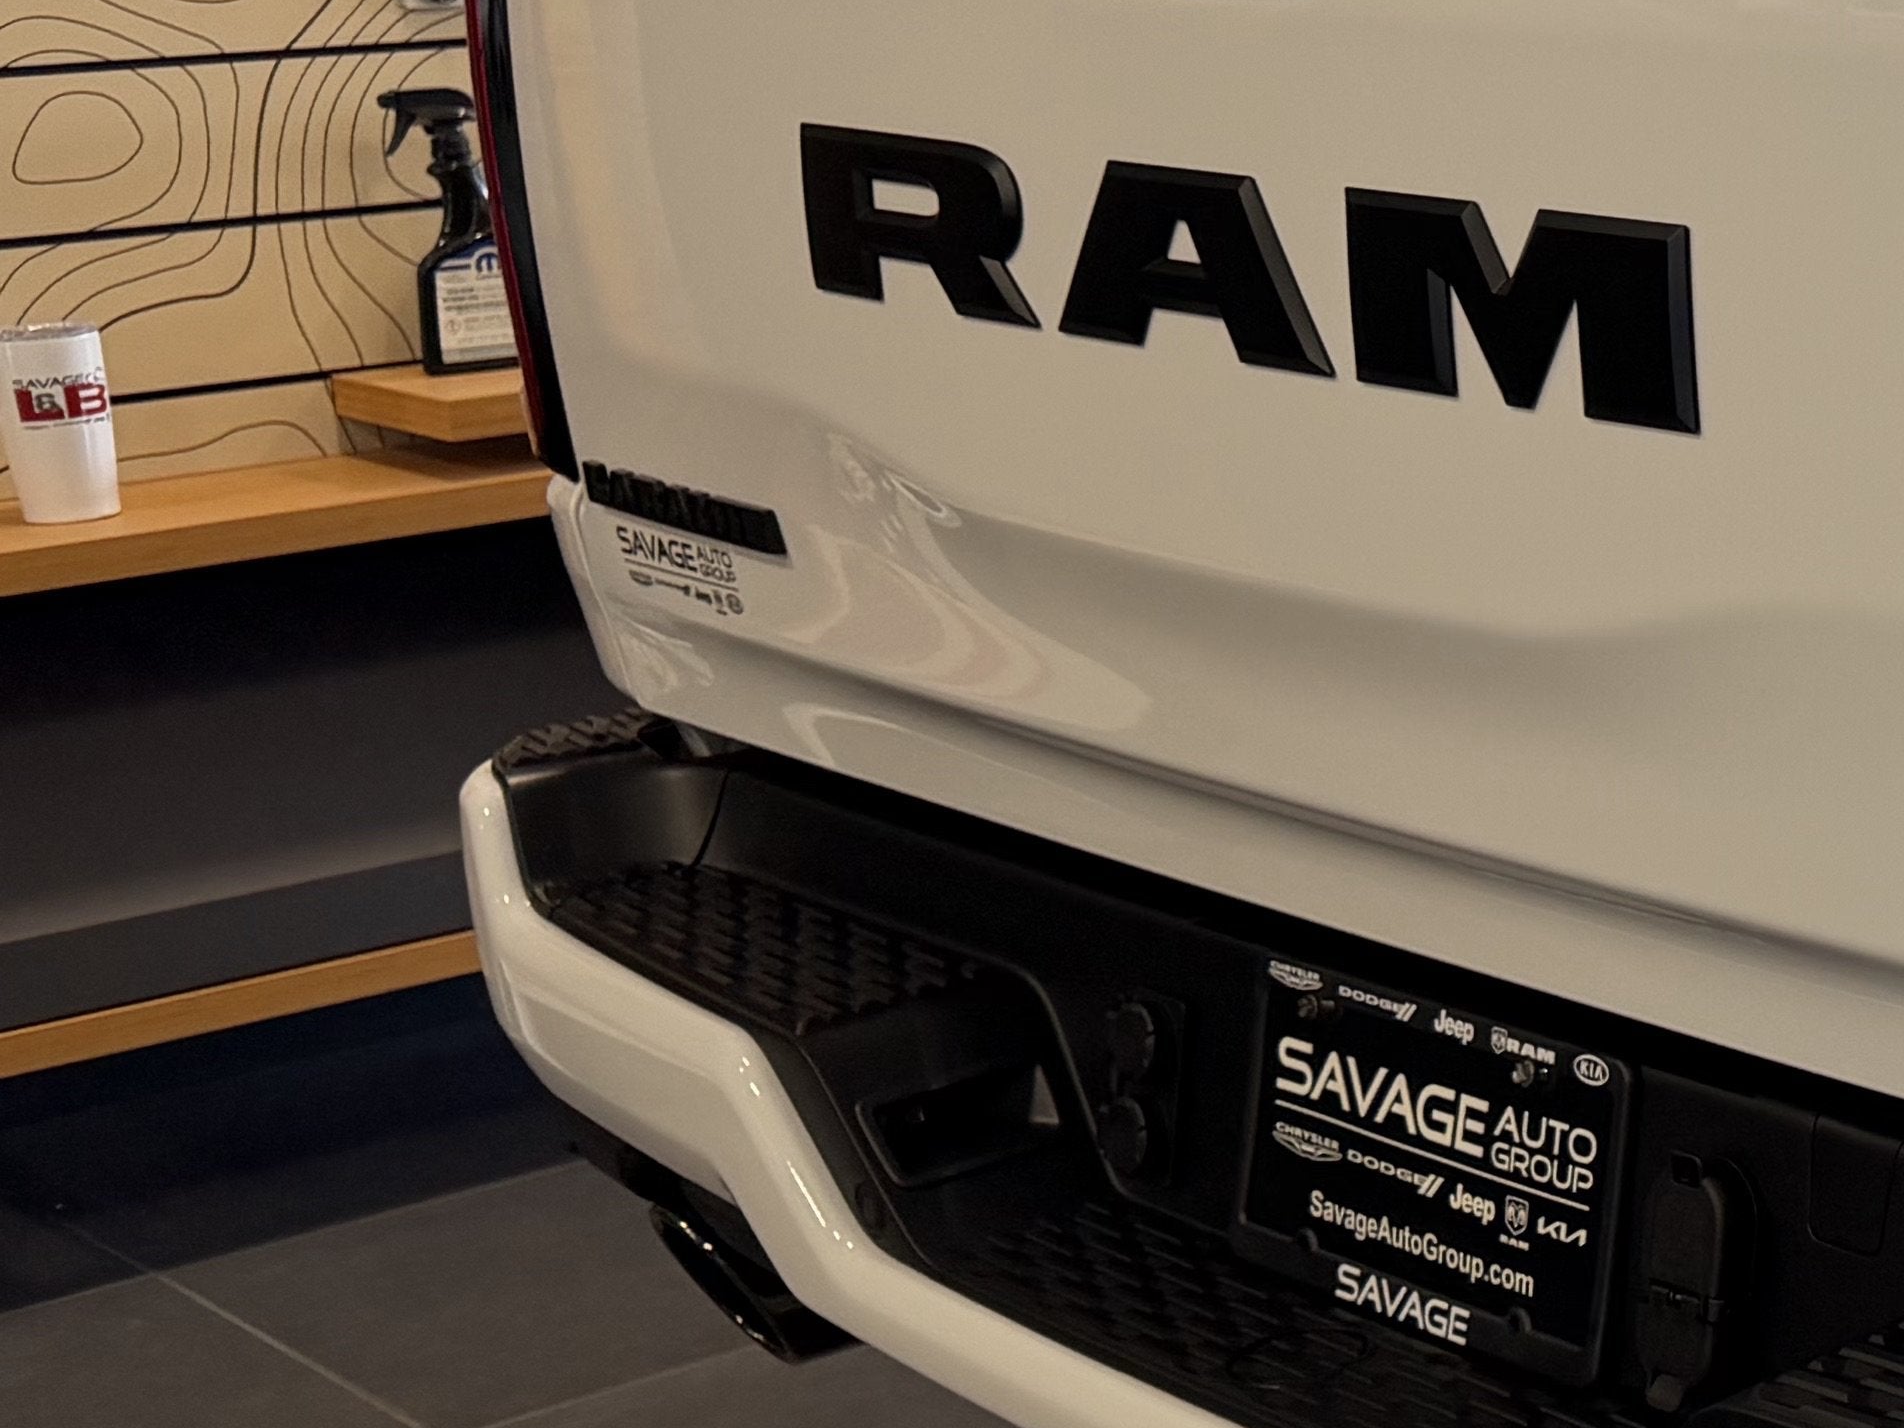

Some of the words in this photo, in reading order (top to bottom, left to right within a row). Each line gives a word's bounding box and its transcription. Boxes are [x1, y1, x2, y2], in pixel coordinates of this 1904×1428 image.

[799, 120, 1702, 437] RAM
[616, 525, 698, 572] SAVAGE
[697, 545, 733, 568] AUTO
[1434, 1009, 1475, 1046] Jeep
[1506, 1037, 1556, 1065] RAM
[1275, 1036, 1490, 1158] SAVAGE
[1493, 1105, 1598, 1165] AUTO
[1275, 1121, 1340, 1152] CHRYSLER
[1346, 1148, 1430, 1189] DODGE
[1449, 1182, 1496, 1226] Jeep
[1490, 1139, 1594, 1194] GROUP
[1308, 1189, 1535, 1298] SavageAutoGroup.com
[1334, 1262, 1471, 1346] SAVAGE
